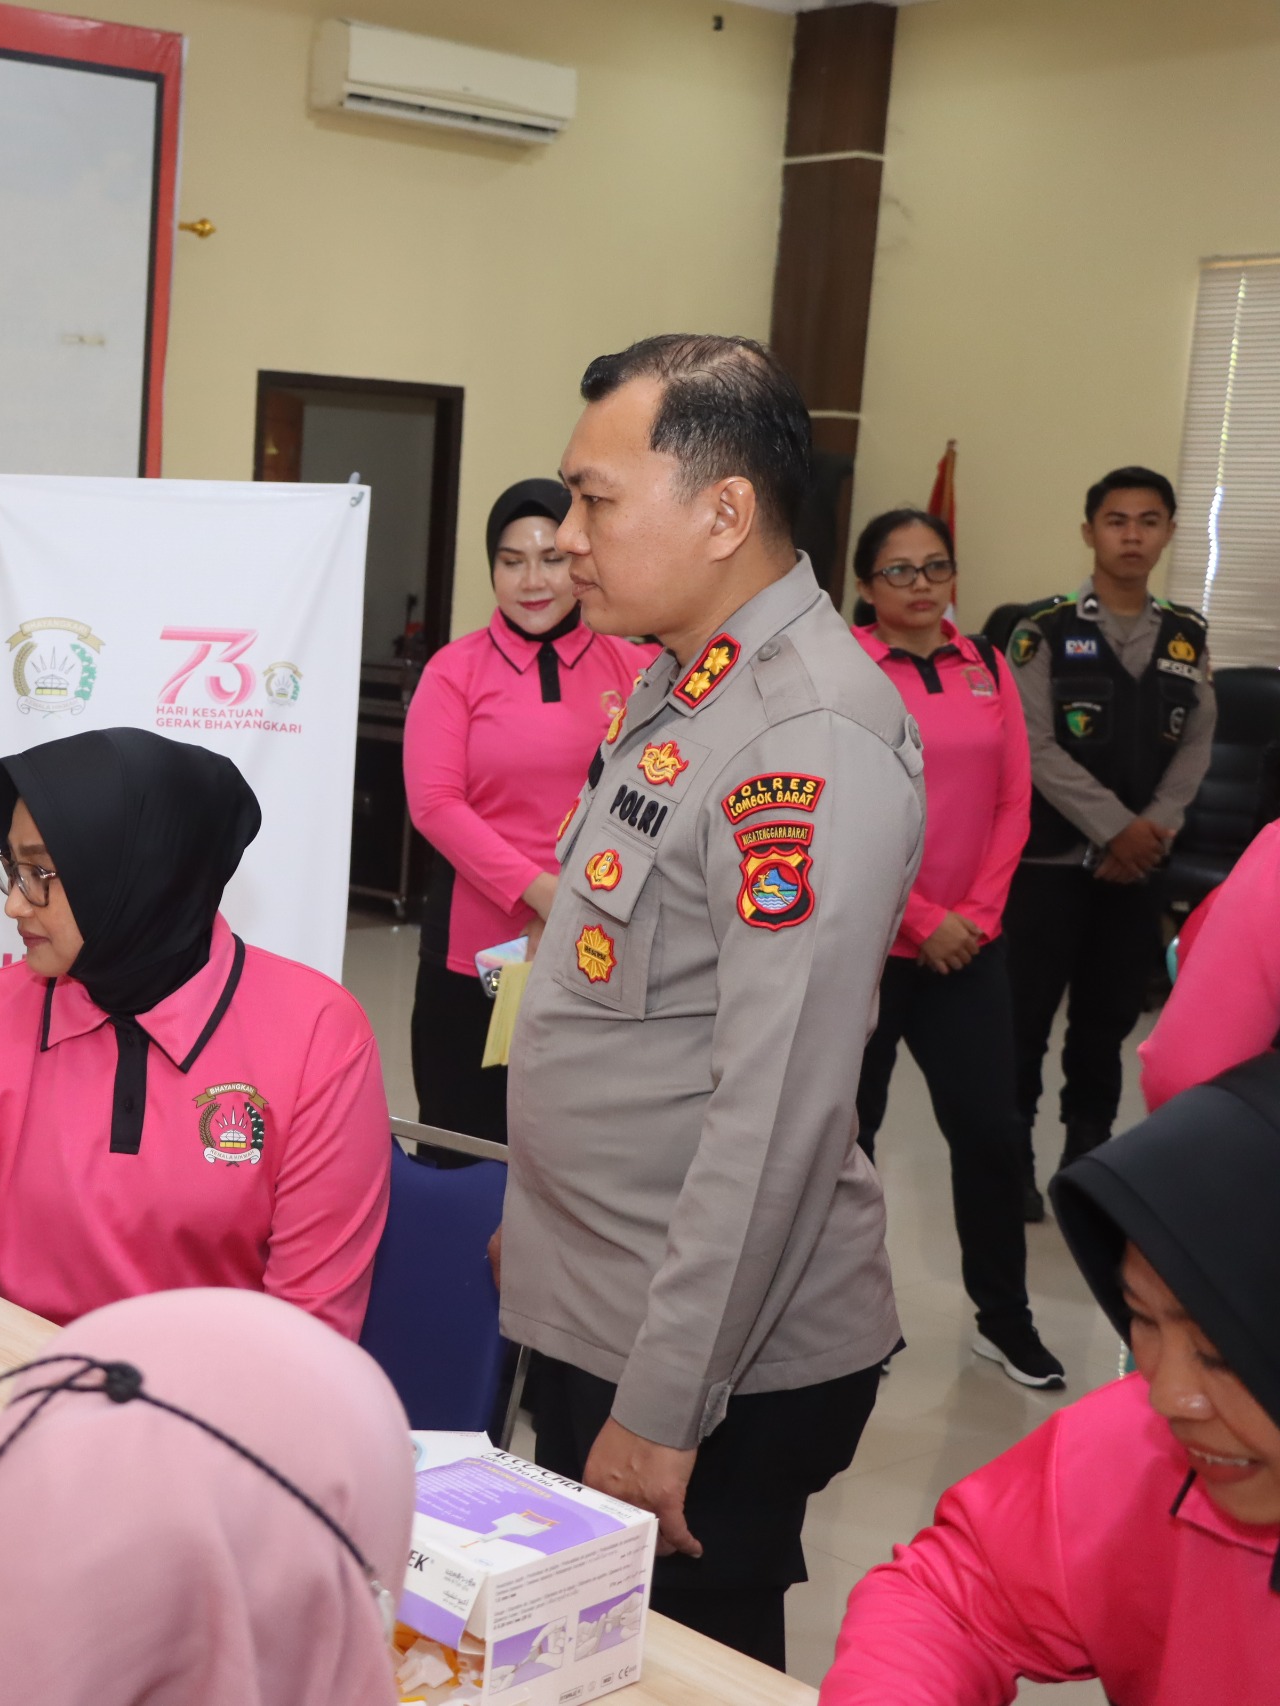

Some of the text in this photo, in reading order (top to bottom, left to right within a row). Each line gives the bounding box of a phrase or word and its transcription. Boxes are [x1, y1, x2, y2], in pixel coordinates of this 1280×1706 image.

[158, 625, 259, 707] 73
[156, 706, 264, 719] HARI KESATUAN
[156, 718, 302, 734] GERAK BHAYANGKARI
[728, 777, 817, 806] POLRES
[730, 790, 814, 817] LOMBOK BARAT
[609, 784, 668, 837] POLRI
[487, 1451, 583, 1493] ACCU-CHEK
